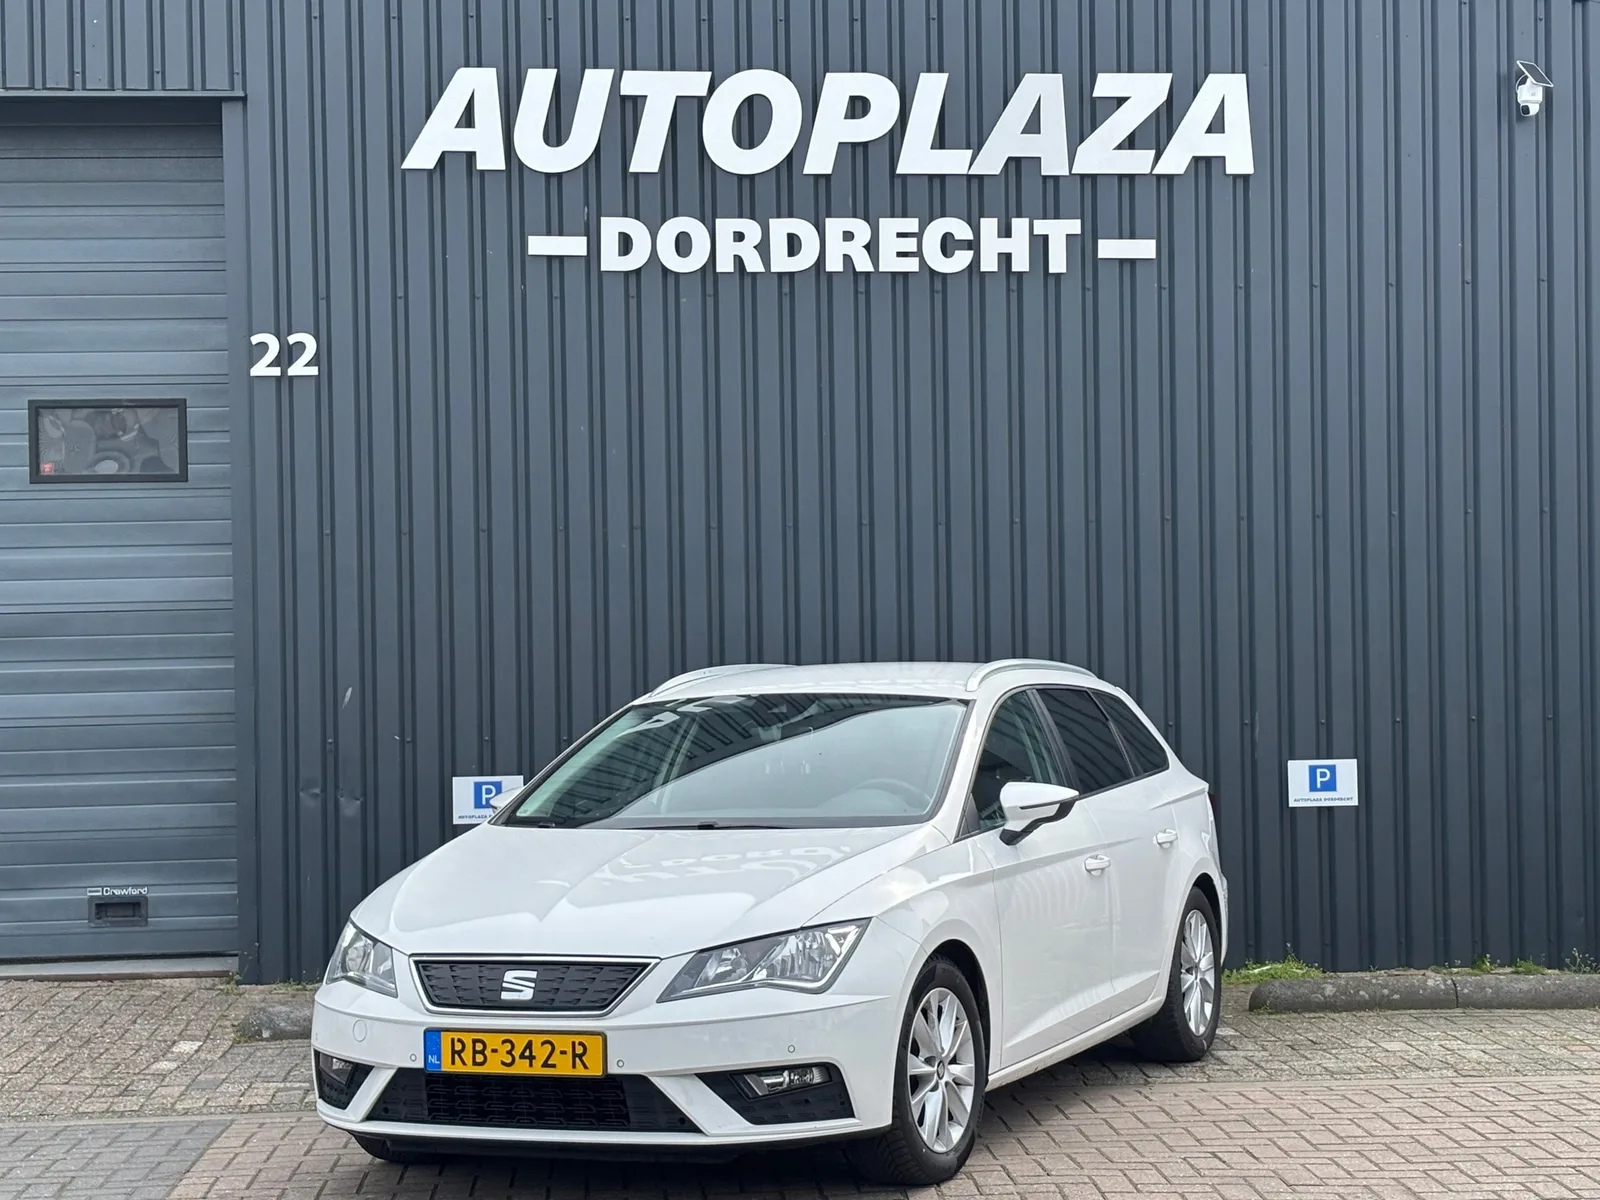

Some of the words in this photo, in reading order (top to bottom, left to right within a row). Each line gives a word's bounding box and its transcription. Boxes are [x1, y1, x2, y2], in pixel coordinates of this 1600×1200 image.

[401, 68, 1254, 175] AUTOPLAZA
[600, 217, 1081, 273] DORDRECHT
[250, 333, 319, 376] 22
[481, 784, 496, 805] P
[1316, 768, 1331, 788] P
[428, 1054, 440, 1064] NL
[450, 1037, 590, 1070] RB-342-R
